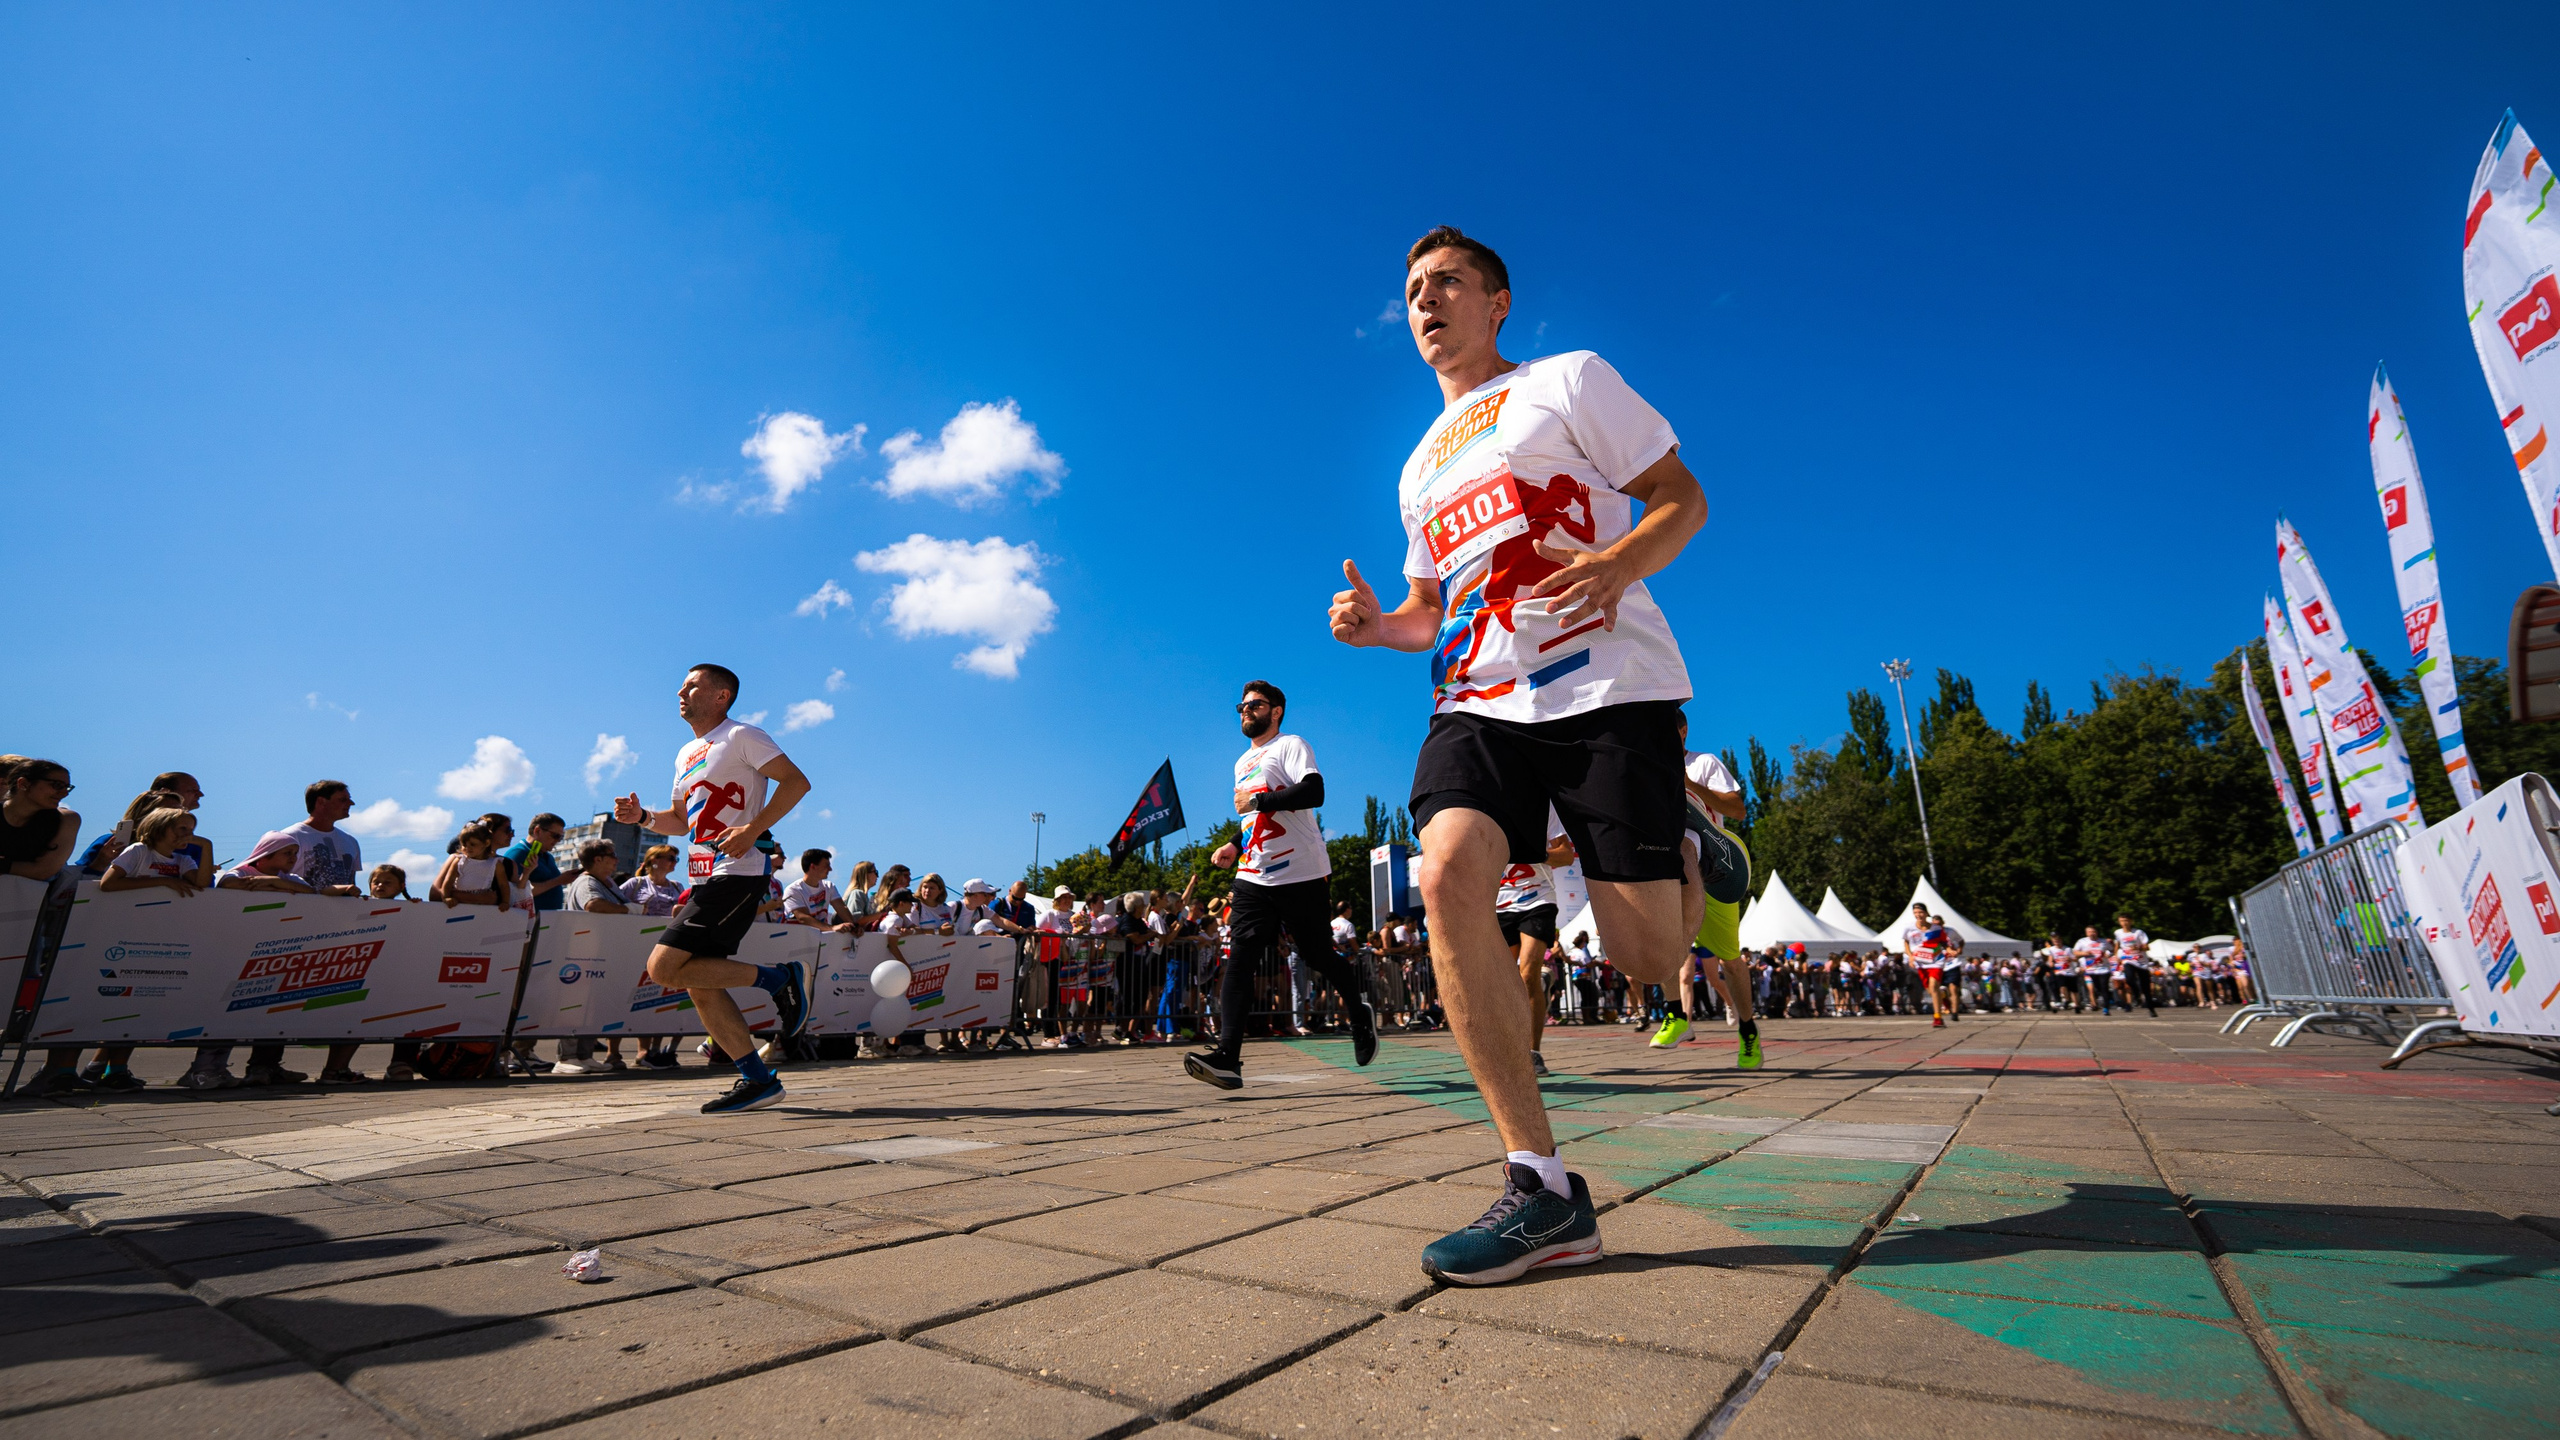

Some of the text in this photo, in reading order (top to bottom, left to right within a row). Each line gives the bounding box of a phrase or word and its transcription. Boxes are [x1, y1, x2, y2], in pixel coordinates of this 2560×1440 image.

[1439, 409, 1496, 464] ЦЕЛИ!
[1442, 483, 1515, 544] 3101
[690, 860, 710, 874] 1901
[255, 924, 387, 949] СПОРТИВНО-МУЗЫКАЛЬНЫЙ
[250, 944, 304, 957] ПРАЗДНИК
[247, 944, 374, 978] ДОСТИГАЯ
[236, 976, 276, 988] ДЛЯ ВСЕЙ
[286, 961, 366, 987] ЦЕЛИ!
[910, 965, 947, 983] ТИГАЯ
[232, 984, 273, 998] СЕМЬИ
[908, 977, 943, 996] ЦЕЛИ!
